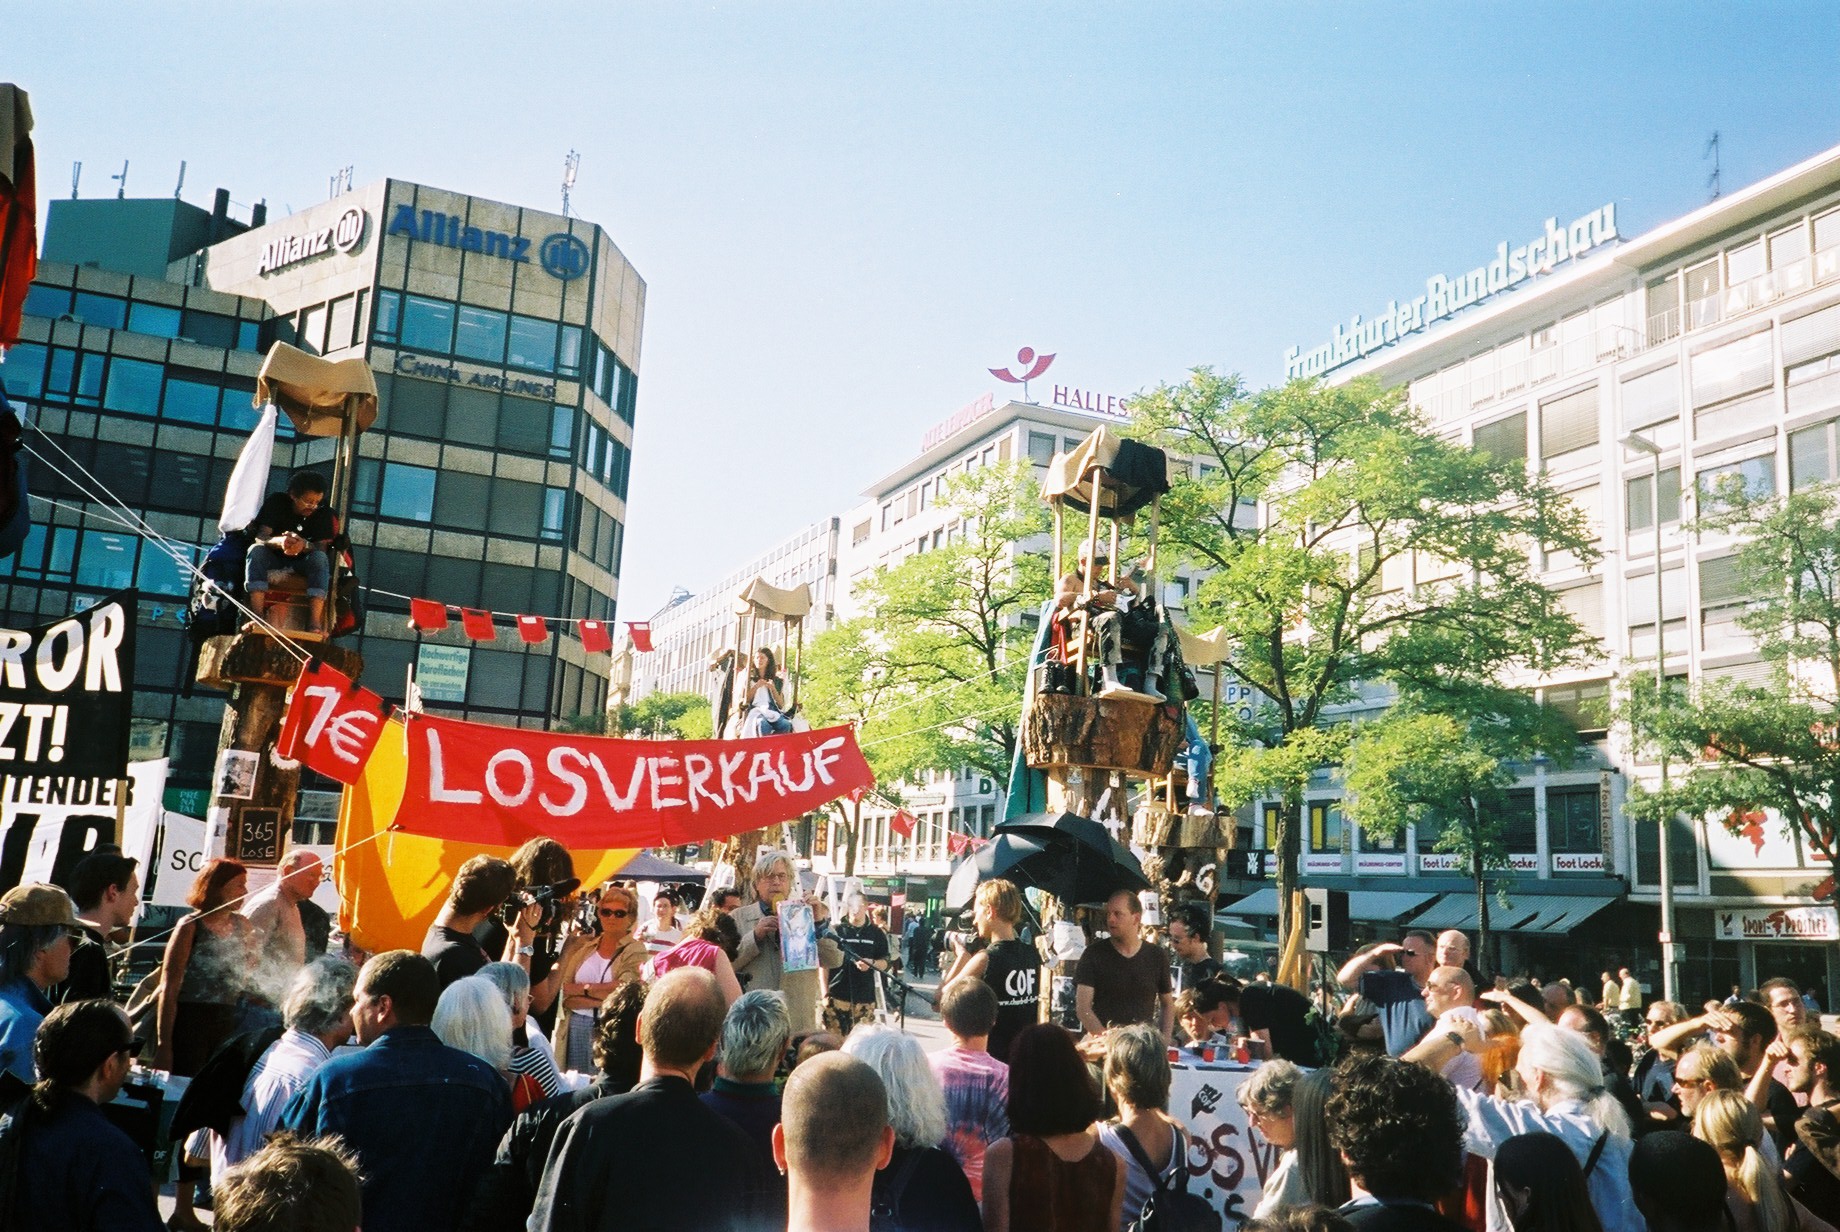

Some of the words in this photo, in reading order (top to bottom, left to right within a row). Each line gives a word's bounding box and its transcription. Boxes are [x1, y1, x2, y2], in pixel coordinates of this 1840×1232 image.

[256, 228, 333, 275] Allianz
[388, 203, 532, 263] Allianz
[1284, 296, 1426, 379] Frankfurter
[1426, 202, 1617, 324] Rundschau
[398, 354, 461, 384] CHINA
[470, 372, 555, 399] AIRLINES
[425, 726, 847, 817] LOSVERKAUF
[241, 845, 275, 858] LOSE
[243, 821, 275, 842] 365
[1005, 968, 1036, 997] COF
